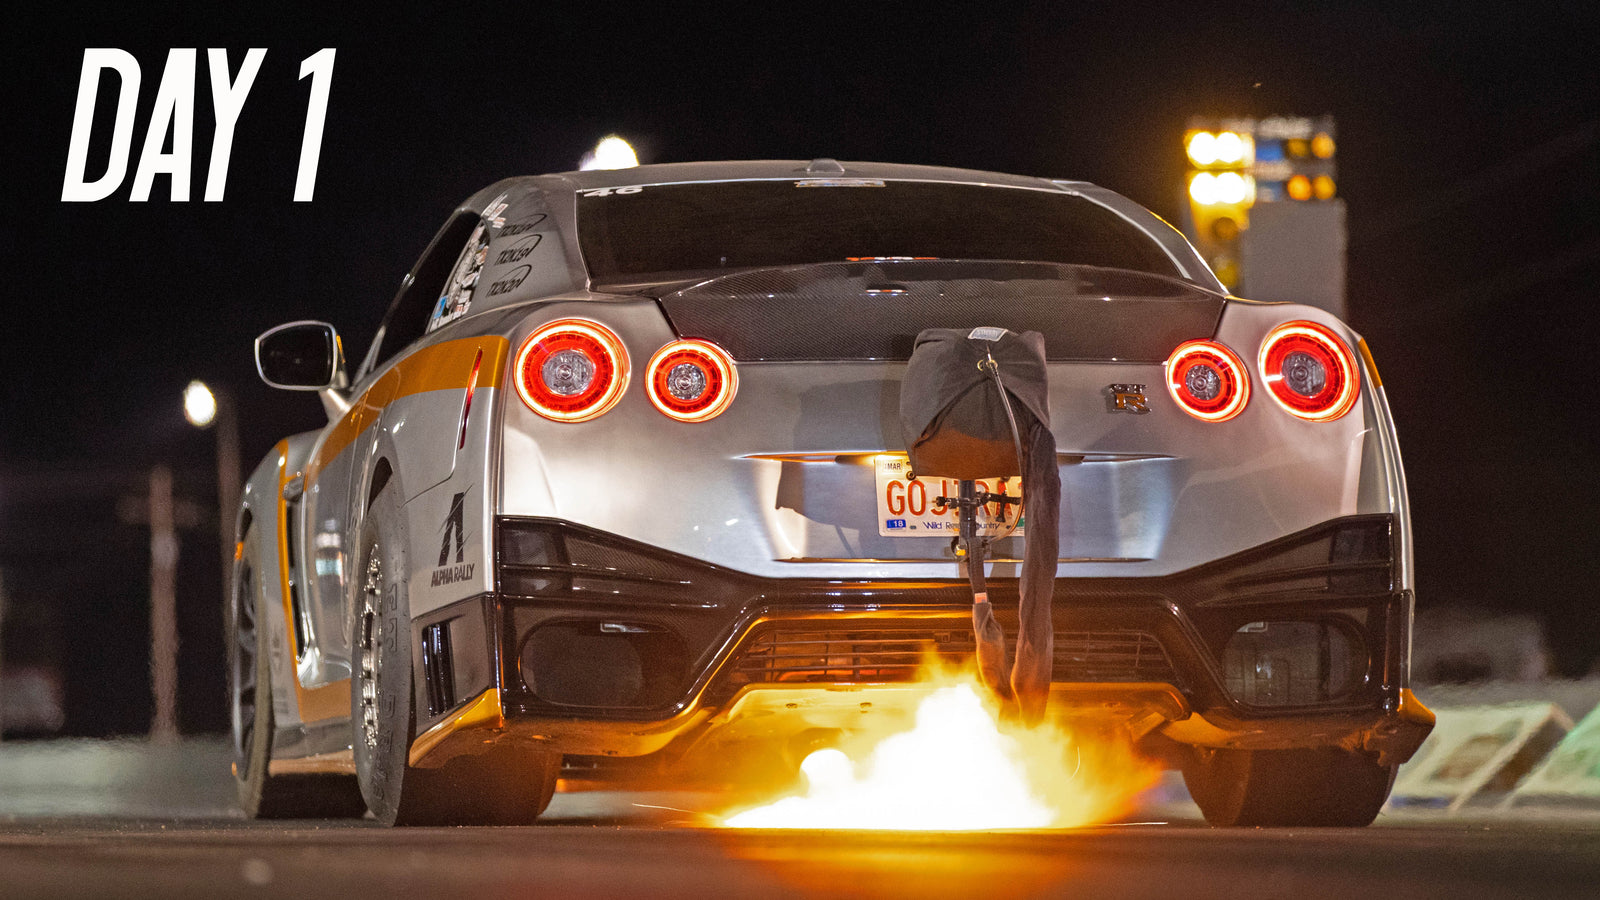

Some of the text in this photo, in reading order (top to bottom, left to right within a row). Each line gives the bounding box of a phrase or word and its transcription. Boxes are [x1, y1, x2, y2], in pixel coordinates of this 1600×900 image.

[922, 521, 942, 530] Wild
[430, 563, 475, 587] ALPHA RALLY
